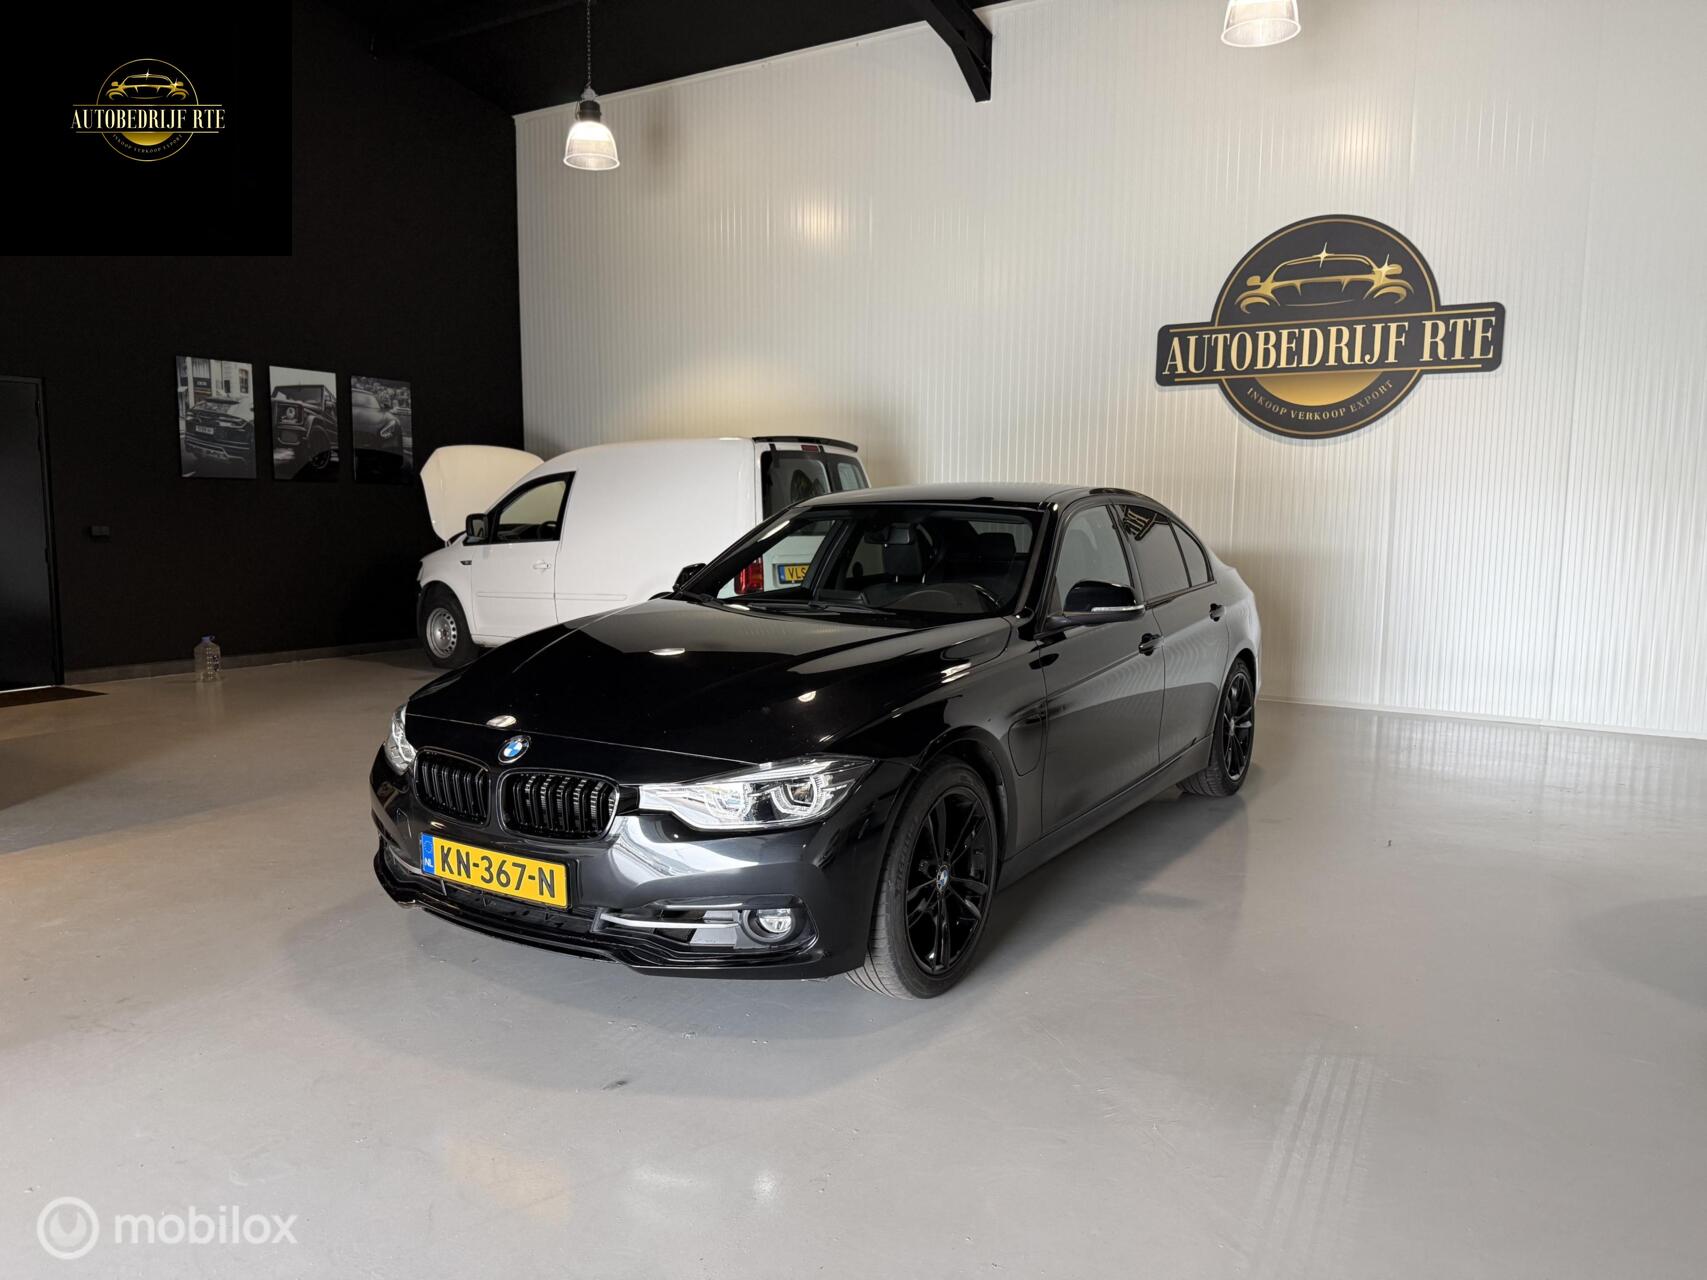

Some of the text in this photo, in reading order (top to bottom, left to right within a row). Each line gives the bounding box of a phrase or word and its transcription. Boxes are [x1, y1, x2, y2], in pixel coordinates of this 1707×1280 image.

[1162, 316, 1496, 375] AUTOBEDRIJF RTE
[1247, 379, 1393, 421] INKOOP VERKOOP EXPORT
[787, 567, 806, 579] VLS
[424, 857, 434, 868] NL
[440, 844, 556, 899] KN-367-N
